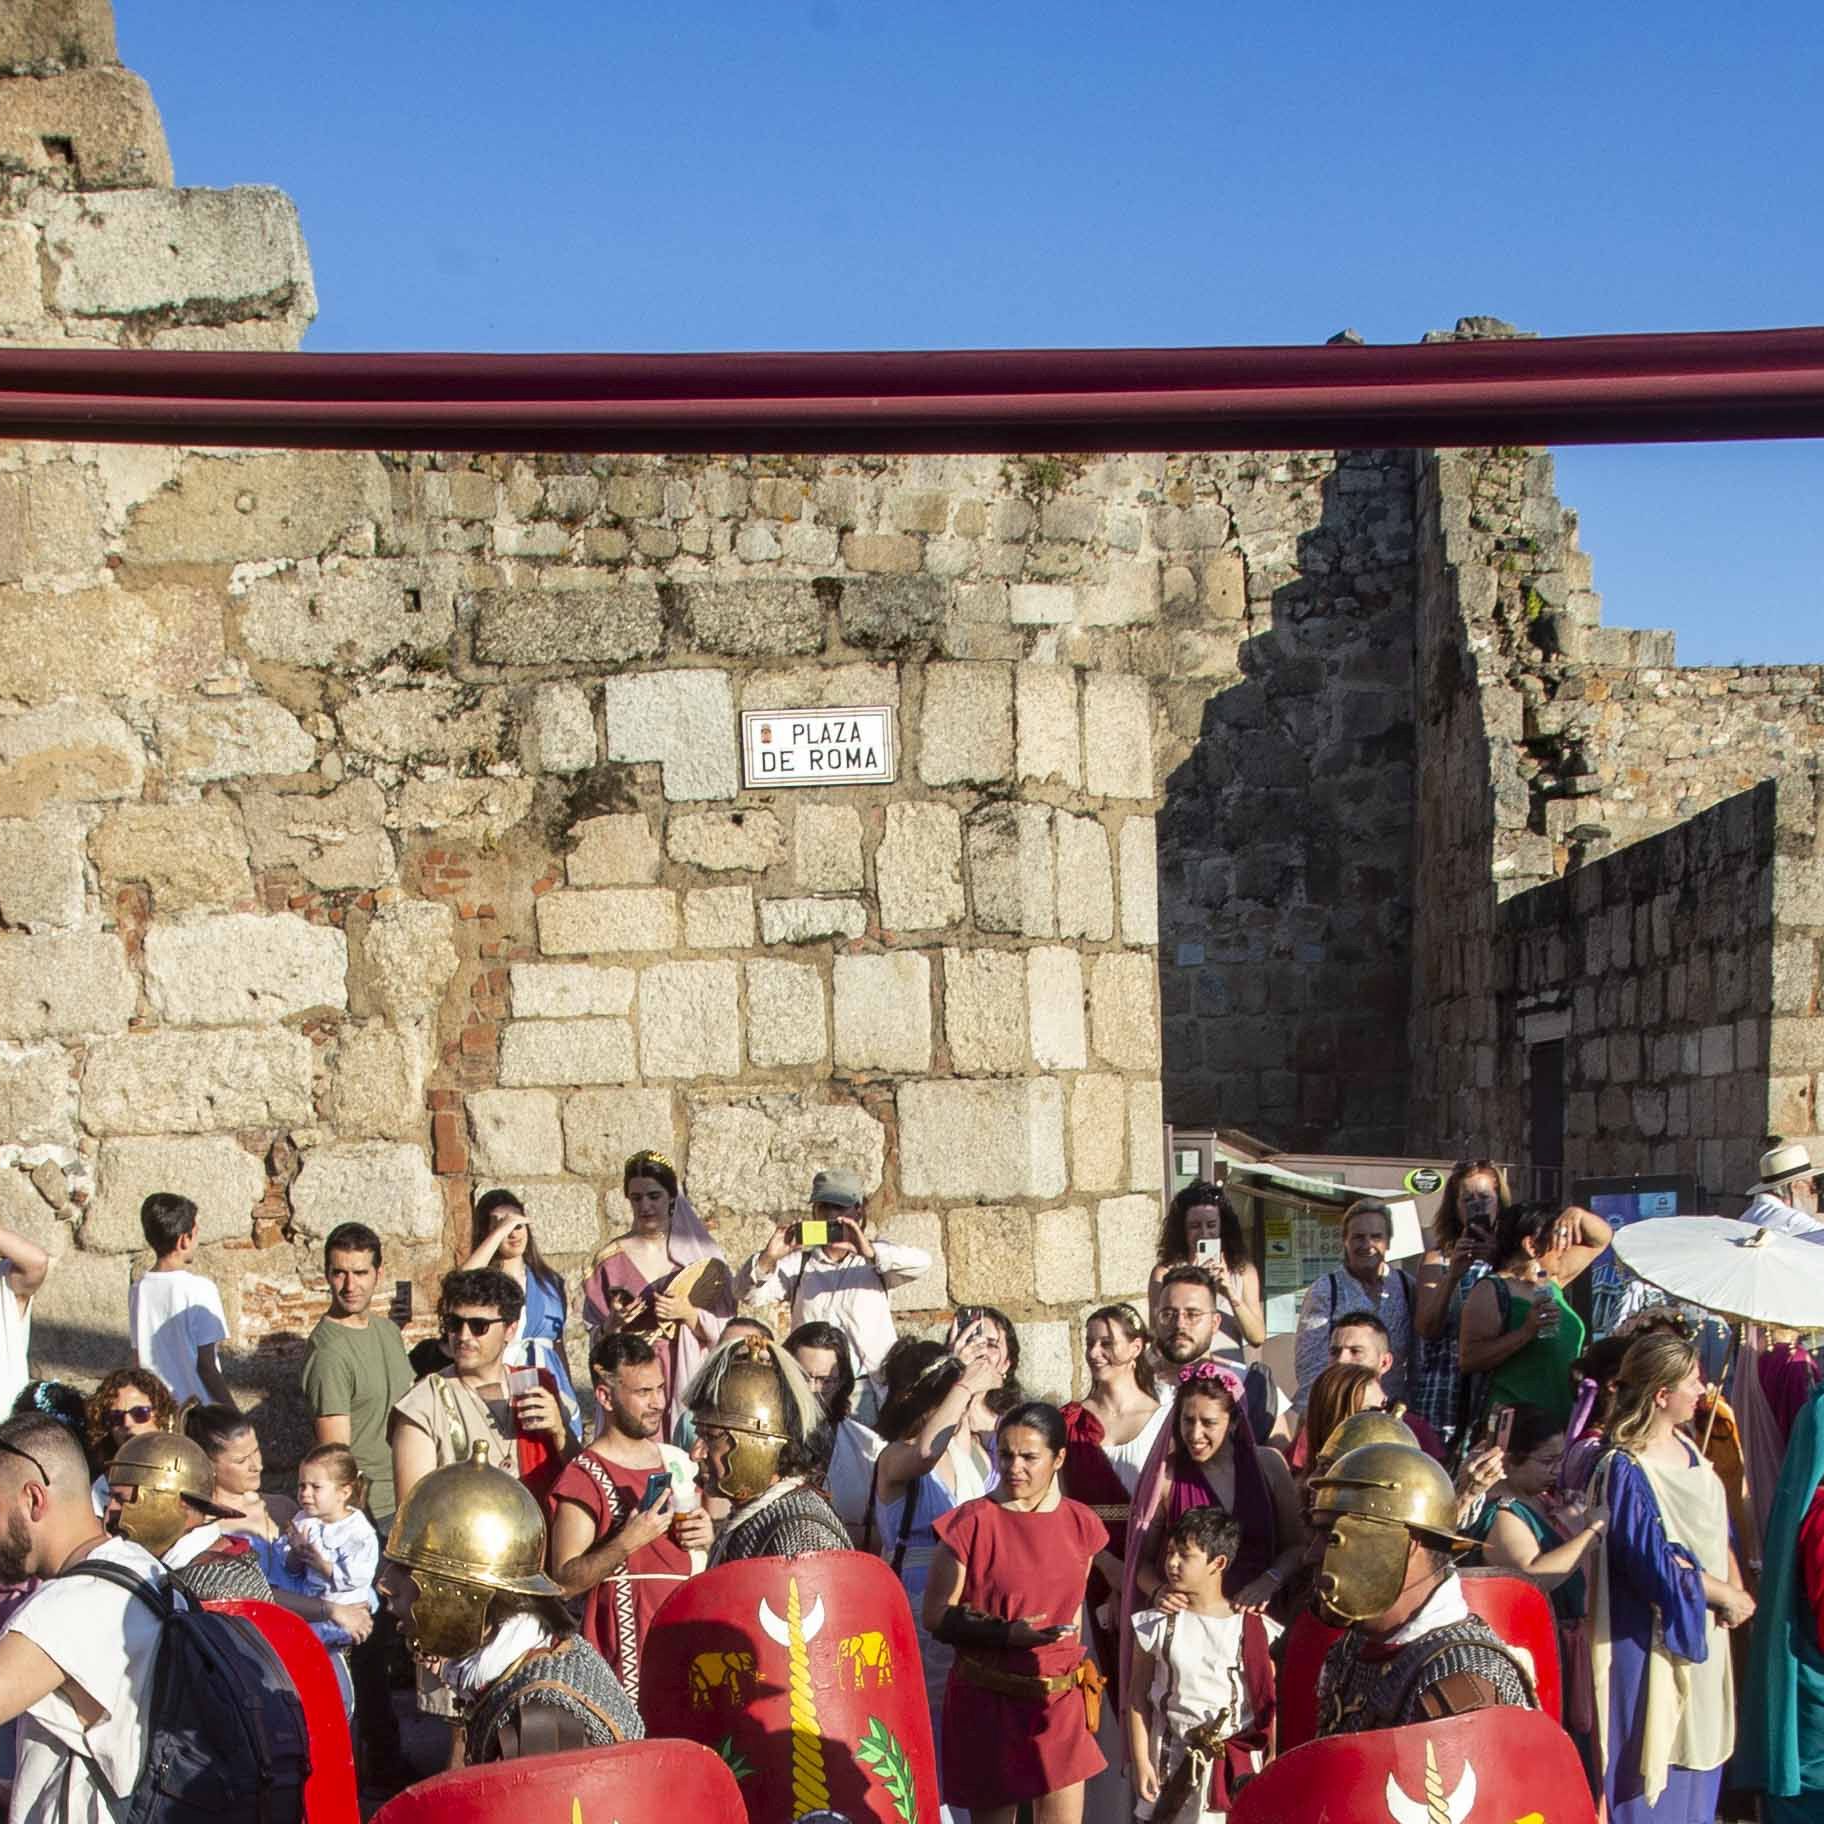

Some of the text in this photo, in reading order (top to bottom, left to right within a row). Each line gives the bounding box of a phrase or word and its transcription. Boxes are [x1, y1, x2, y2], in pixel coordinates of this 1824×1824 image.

[792, 721, 862, 745] PLAZA
[762, 747, 878, 772] DE ROMA
